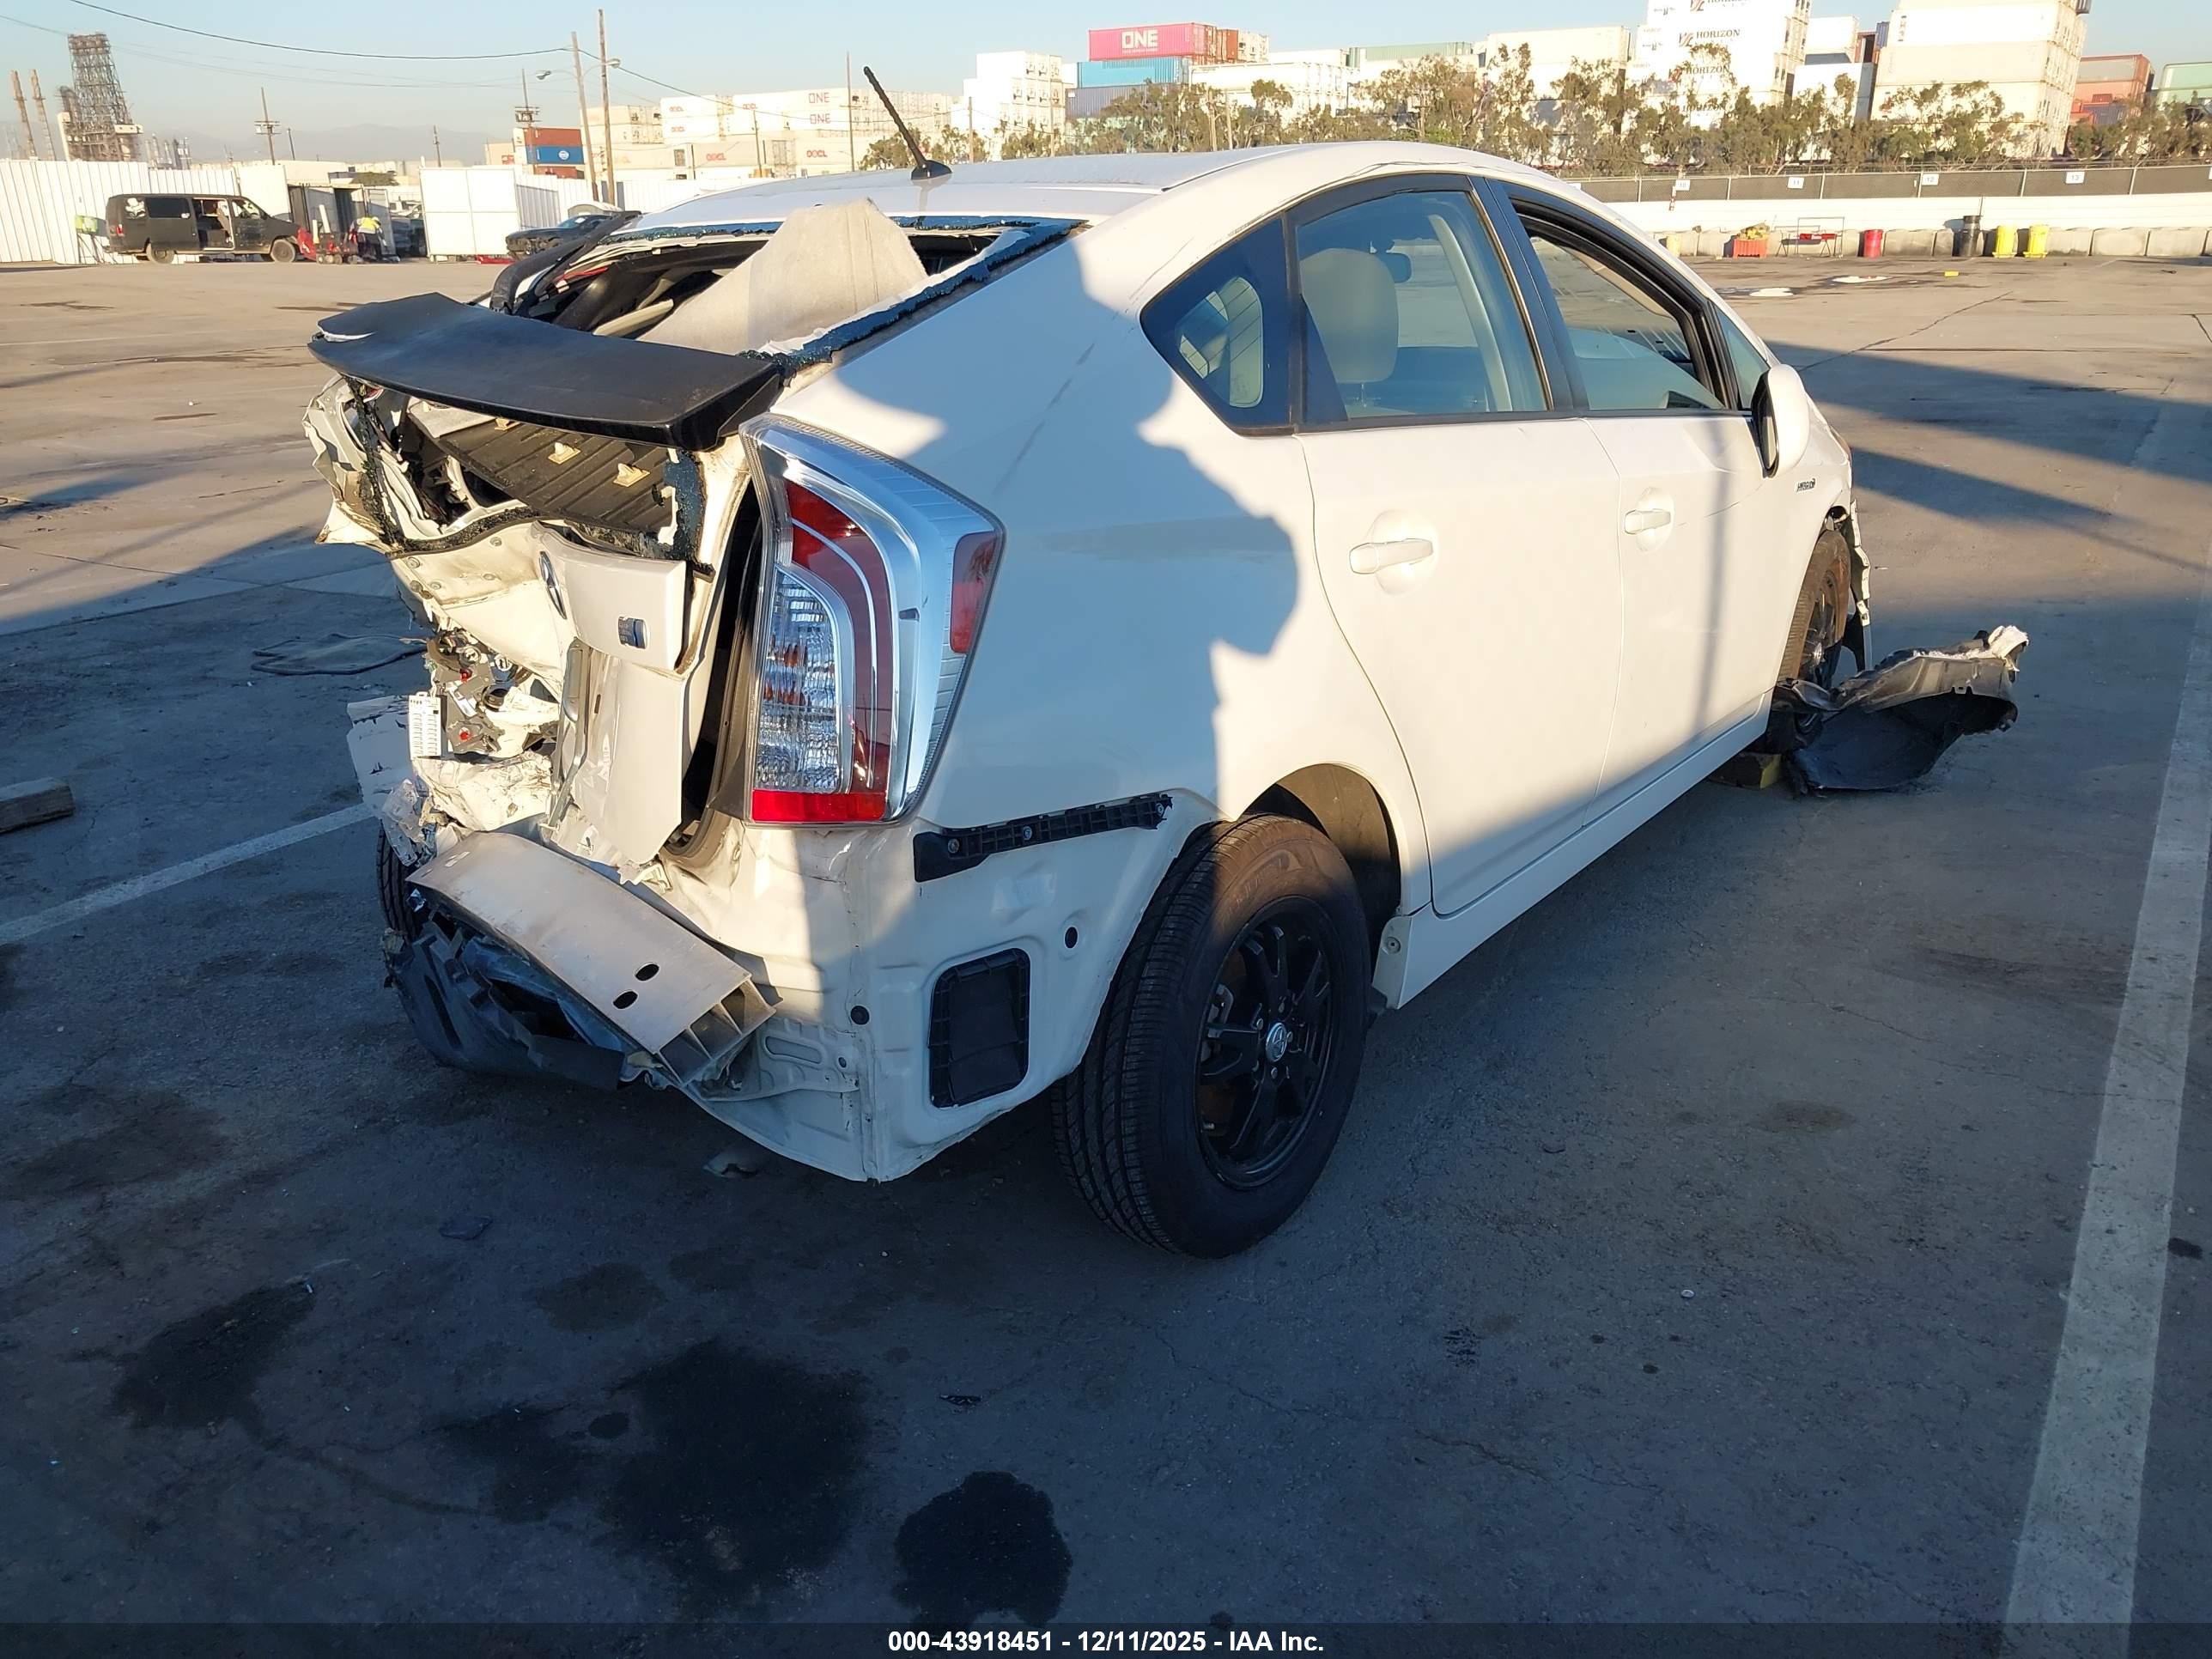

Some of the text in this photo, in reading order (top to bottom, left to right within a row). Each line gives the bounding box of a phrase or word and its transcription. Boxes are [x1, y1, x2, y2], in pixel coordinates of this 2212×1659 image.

[1121, 29, 1158, 49] ONE
[1696, 28, 1741, 40] HORIZON
[808, 92, 830, 104] ONE
[810, 112, 832, 125] ONE
[806, 149, 828, 158] OOCL
